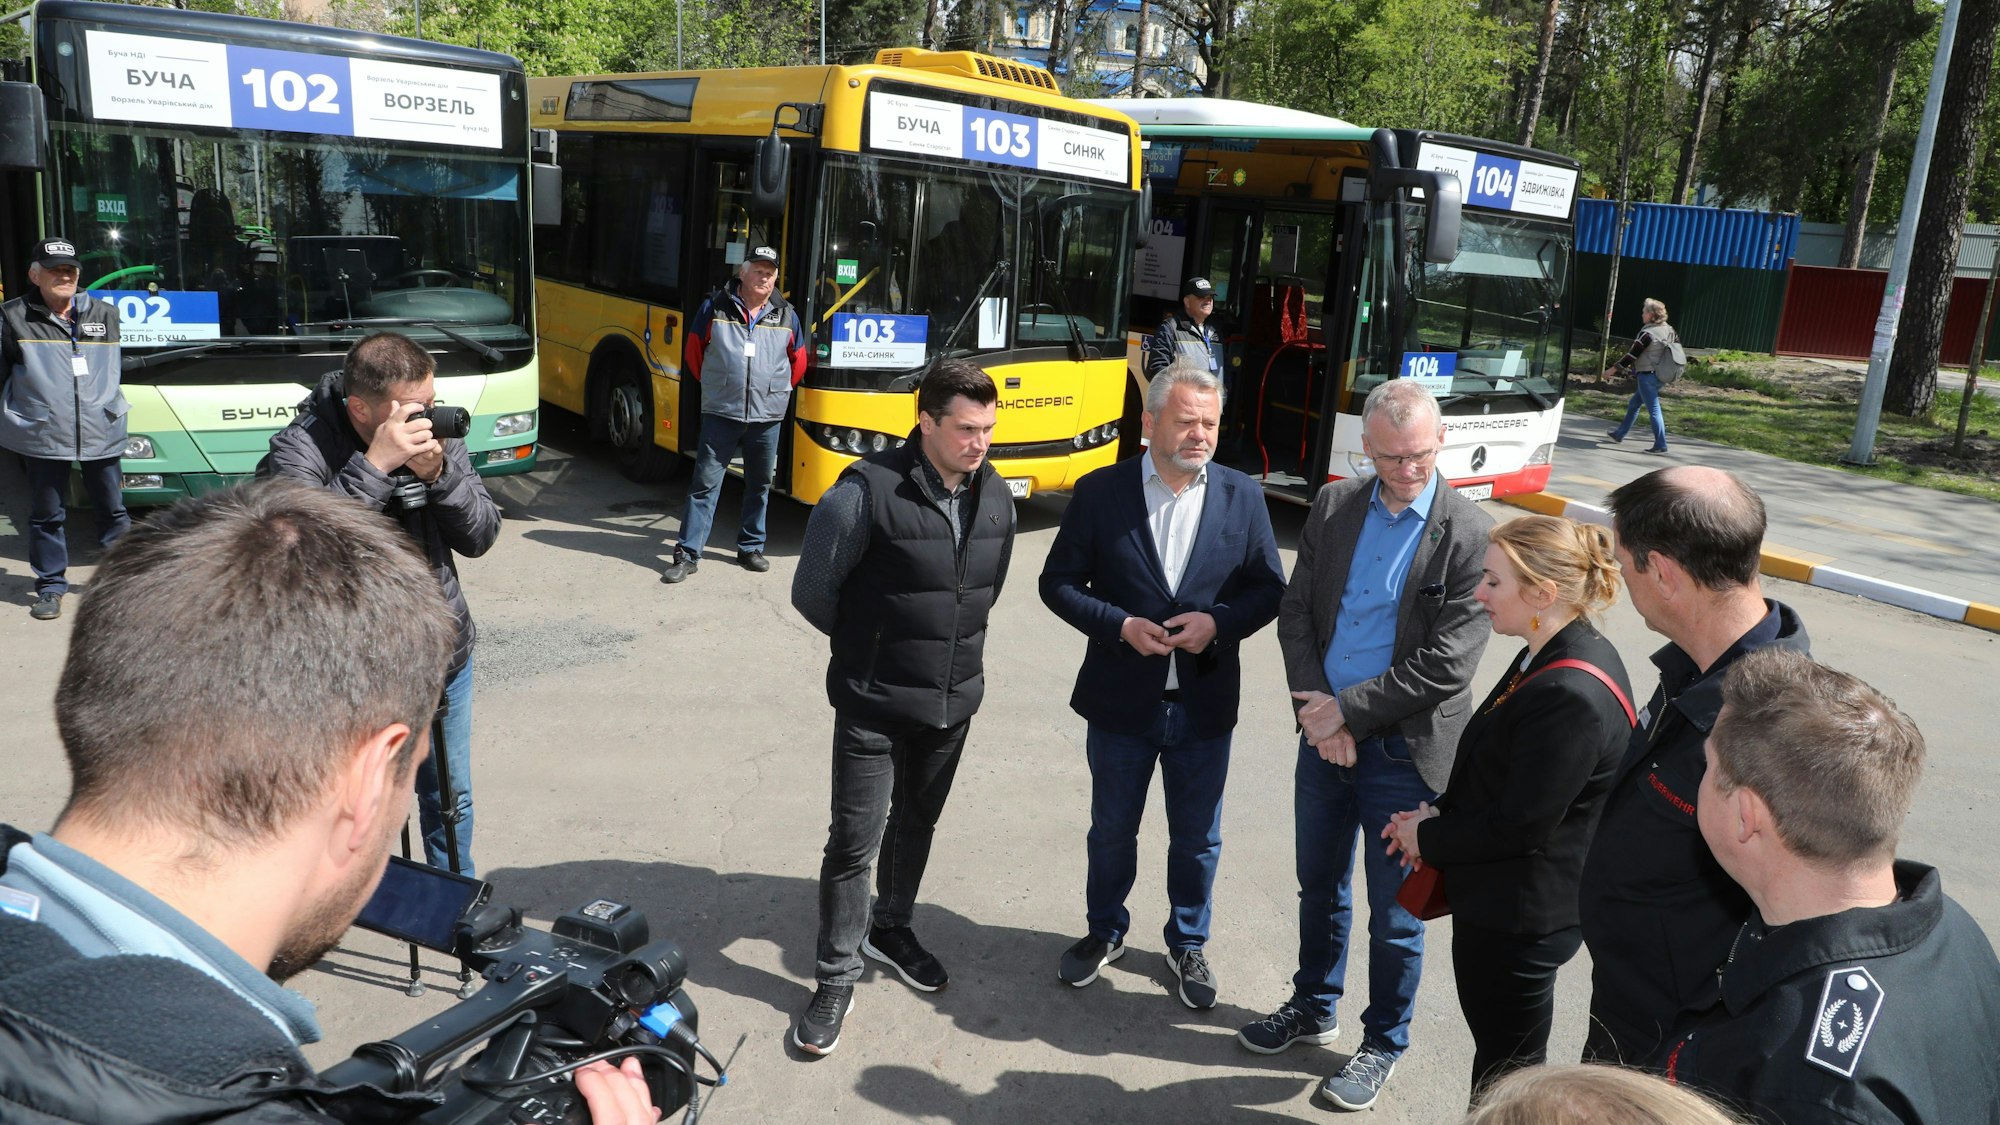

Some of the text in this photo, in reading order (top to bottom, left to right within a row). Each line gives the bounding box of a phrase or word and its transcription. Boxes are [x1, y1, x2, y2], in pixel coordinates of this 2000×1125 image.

[108, 49, 146, 60] Буча НДІ
[126, 68, 196, 90] БУЧА
[111, 95, 146, 105] Ворзель
[242, 68, 340, 114] 102
[384, 92, 475, 116] ВОРЗЕЛЬ
[897, 115, 941, 135] БУЧА
[970, 117, 1031, 159] 103
[1063, 141, 1105, 161] СИНЯК
[1476, 166, 1513, 198] 104
[1520, 181, 1566, 199] ЗДВИЖІВКА
[97, 199, 127, 216] ВХІД
[837, 264, 857, 278] ВХІД
[119, 334, 187, 342] ЗЕЛЬ-БУЧА
[844, 318, 895, 344] 103
[842, 351, 895, 359] БУЧА-СИНЯК
[1408, 356, 1439, 378] 104
[996, 396, 1073, 410] АНССЕРВІС
[1647, 772, 1695, 816] FEUERWEHR
